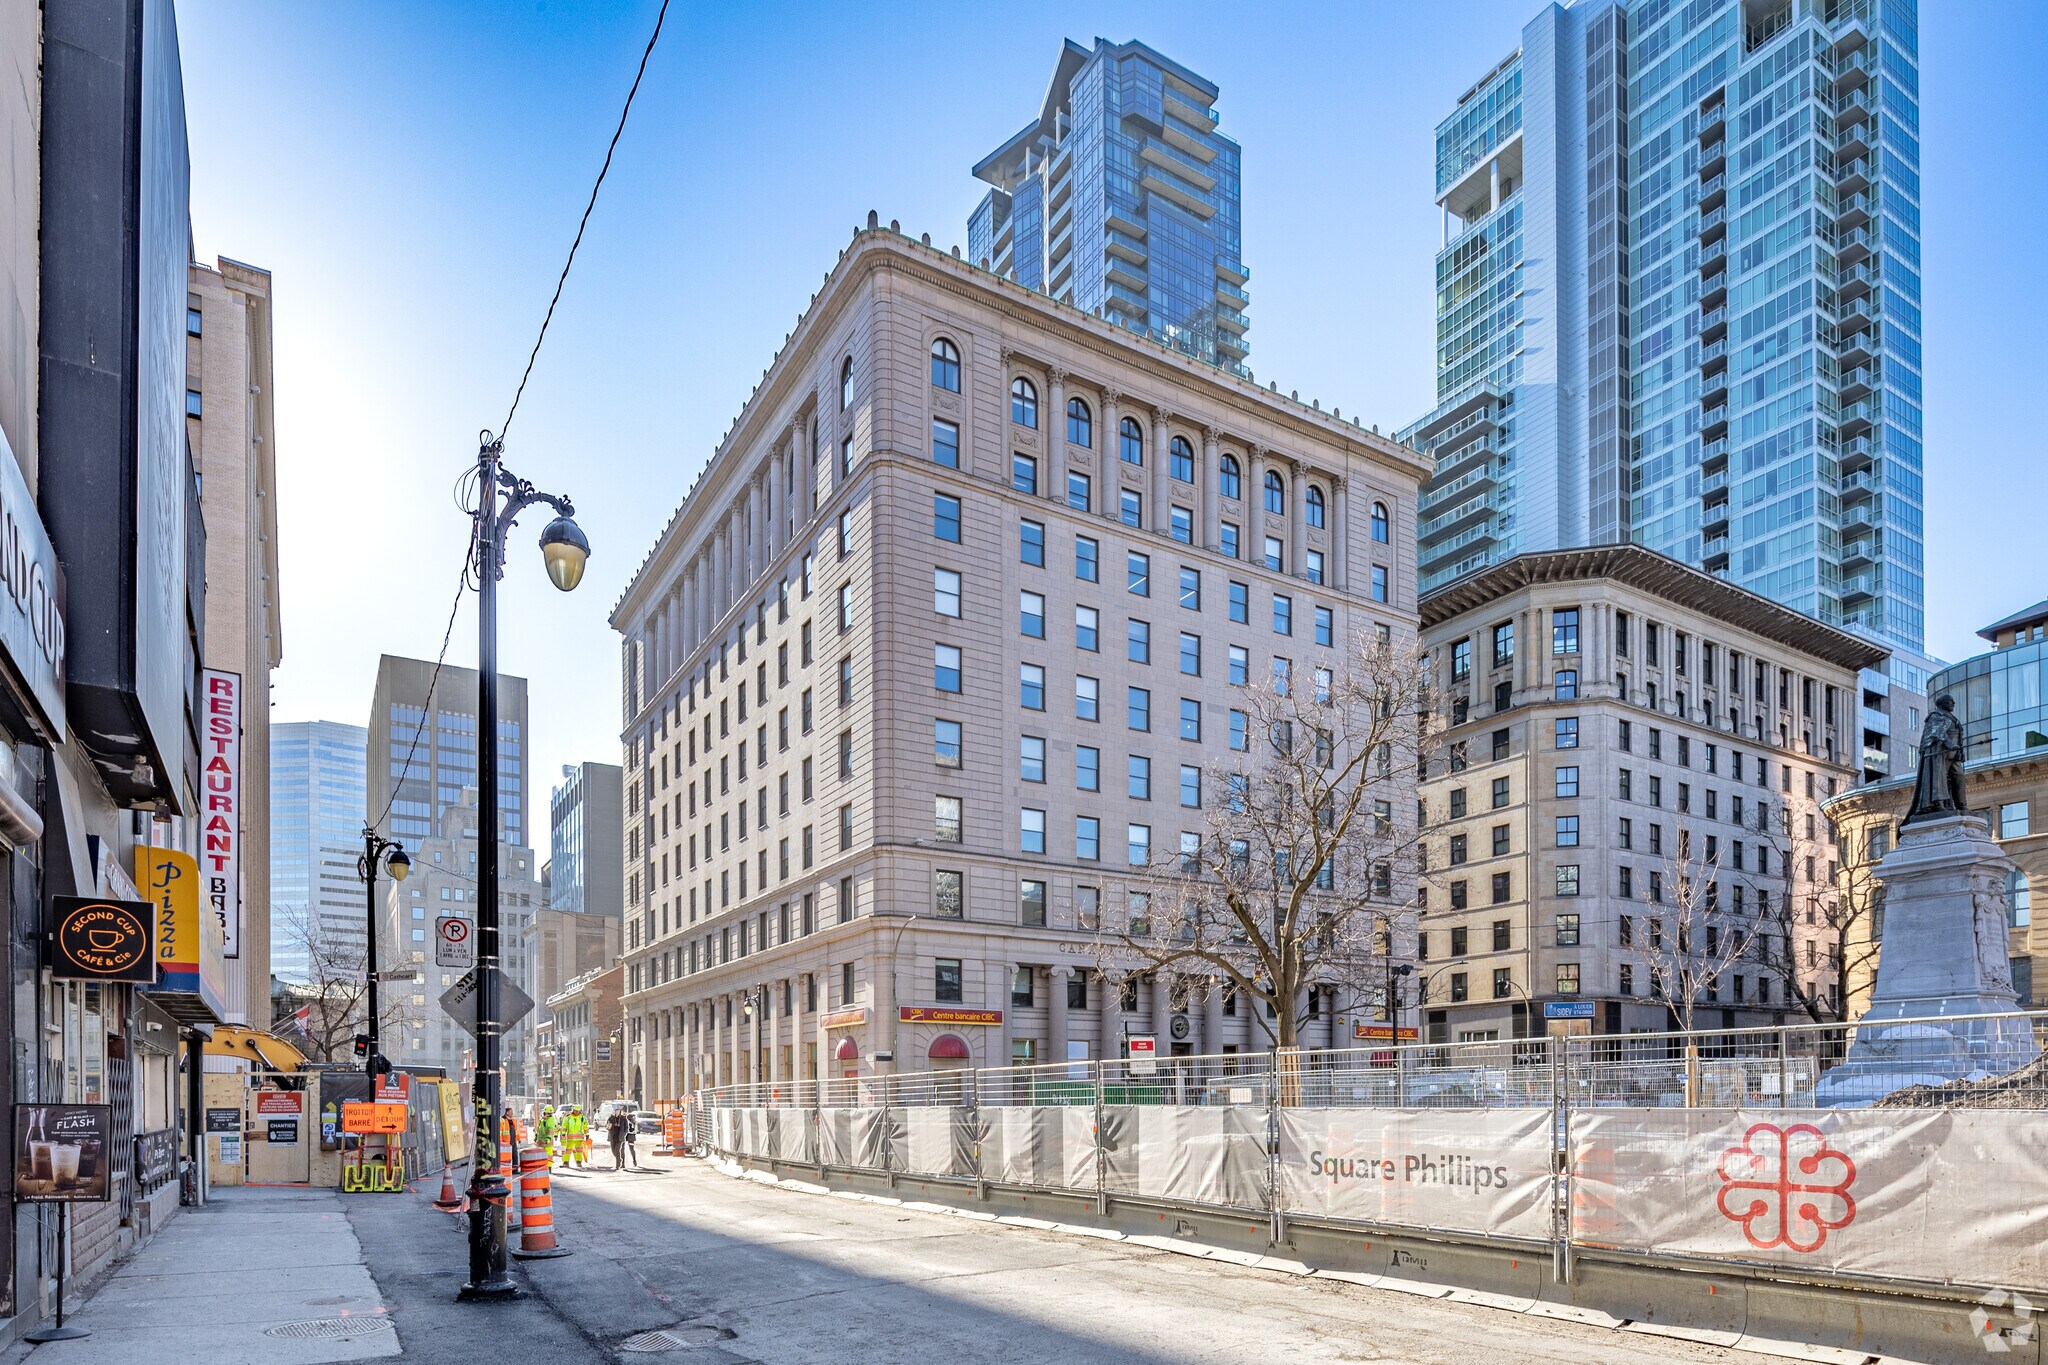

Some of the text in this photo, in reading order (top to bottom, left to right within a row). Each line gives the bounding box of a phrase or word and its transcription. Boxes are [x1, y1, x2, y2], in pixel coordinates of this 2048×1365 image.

[30, 561, 65, 679] CUP
[205, 677, 233, 872] RESTAURANT
[152, 861, 182, 958] Pizza
[71, 911, 136, 936] SECOND CUP
[77, 949, 132, 966] CAFÉ & Cie
[389, 972, 413, 980] Cathcart
[932, 1011, 996, 1021] Centre bancaire CIBC
[1369, 1028, 1385, 1036] Centre
[56, 1118, 95, 1130] FLASH
[349, 1119, 371, 1127] BARRÉ
[1310, 1150, 1509, 1195] Square Phillips
